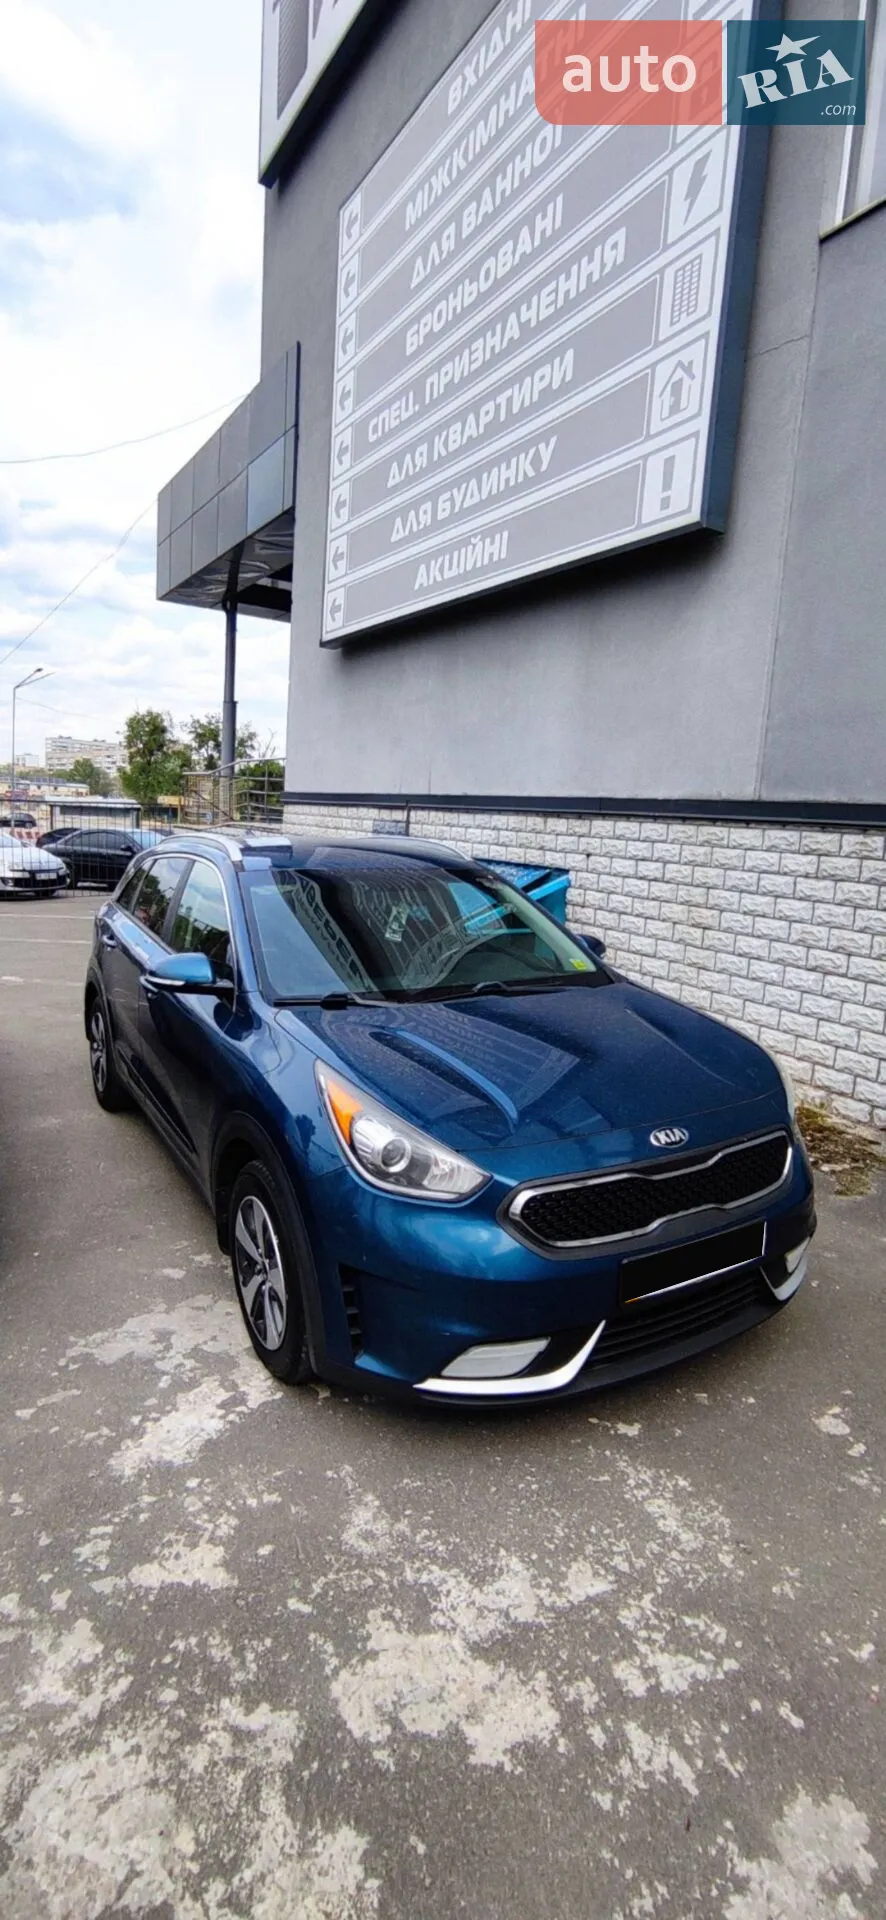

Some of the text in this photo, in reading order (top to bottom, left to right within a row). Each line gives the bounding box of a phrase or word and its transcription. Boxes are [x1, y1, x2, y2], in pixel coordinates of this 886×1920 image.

[405, 194, 563, 356] БРОНЬОВАНІ
[410, 226, 455, 290] ДЛЯ
[367, 226, 627, 442] СПЕЦ. ПРИЗНАЧЕННЯ
[387, 348, 575, 488] ДЛЯ КВАРТИРИ
[390, 436, 559, 542] ДЛЯ БУДИНКУ
[414, 530, 509, 591] АКЦІЙНІ
[655, 1128, 686, 1145] KIA
